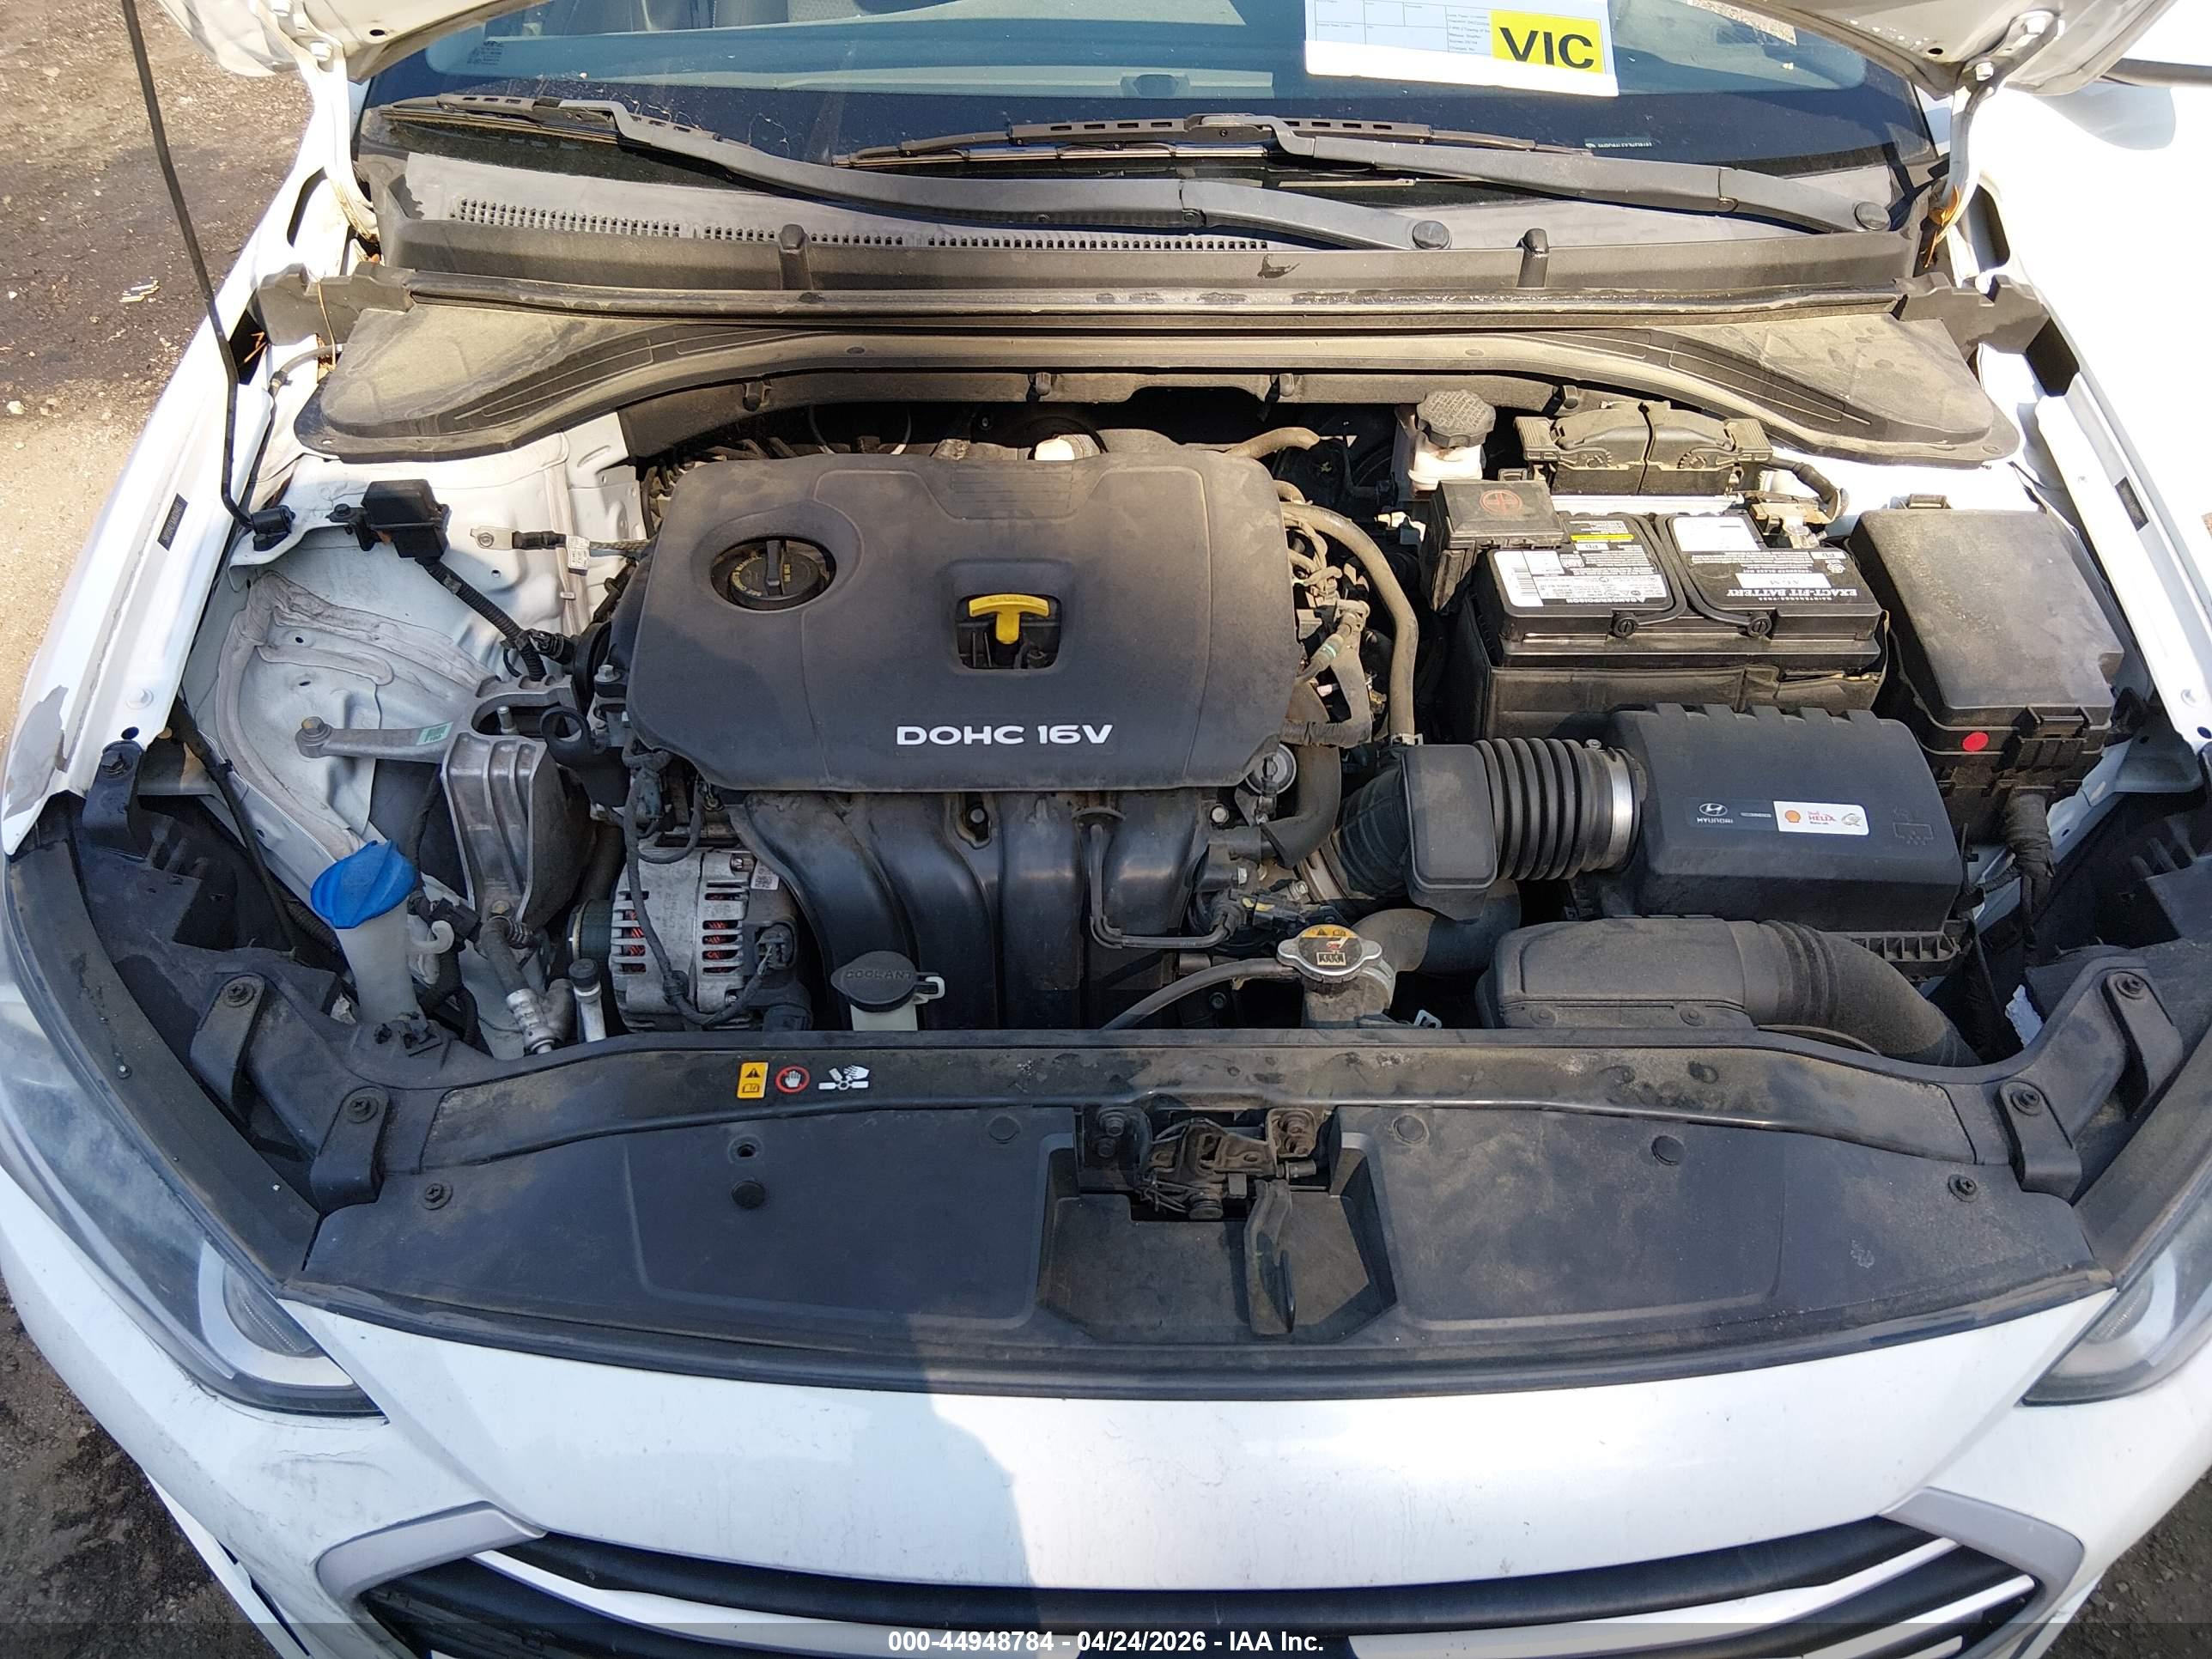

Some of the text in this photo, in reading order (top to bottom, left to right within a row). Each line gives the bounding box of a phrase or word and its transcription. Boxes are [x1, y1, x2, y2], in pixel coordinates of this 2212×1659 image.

[1498, 27, 1595, 69] VIC
[1727, 588, 1857, 598] EXACT-FIT BATTERY
[896, 724, 1114, 745] DOHC 16V
[1808, 813, 1837, 822] HELIX
[844, 969, 912, 981] COOLANT
